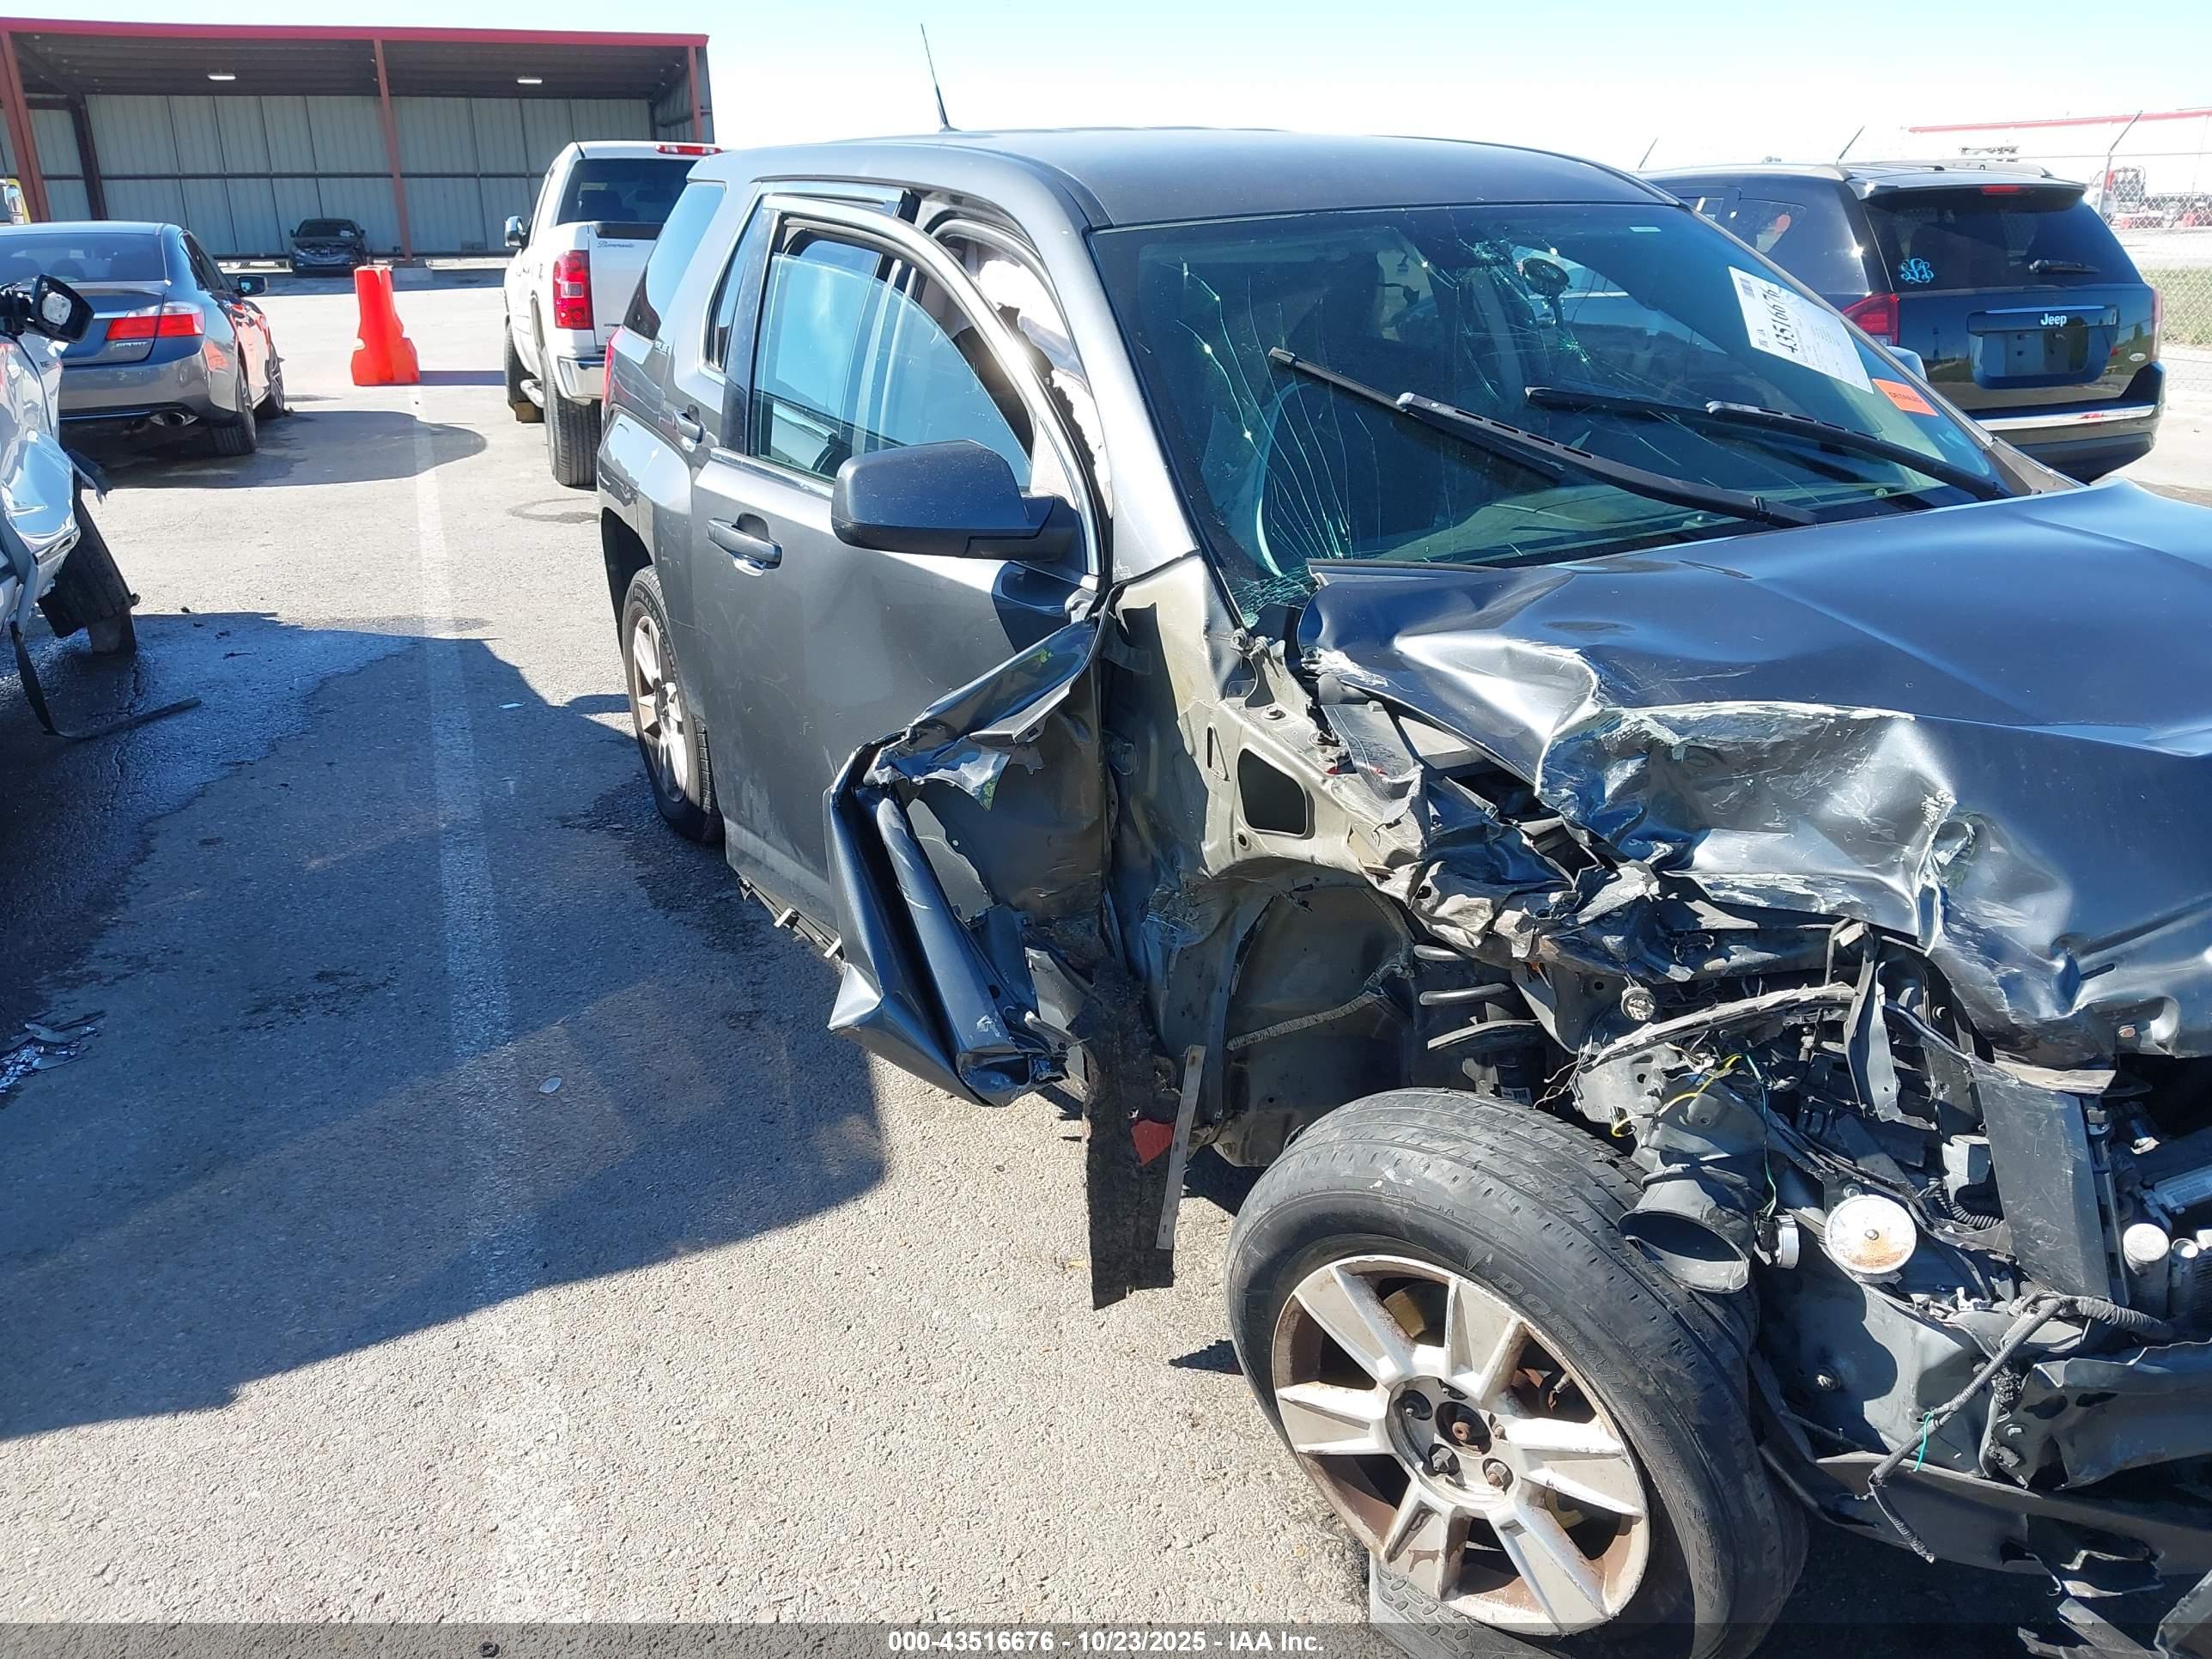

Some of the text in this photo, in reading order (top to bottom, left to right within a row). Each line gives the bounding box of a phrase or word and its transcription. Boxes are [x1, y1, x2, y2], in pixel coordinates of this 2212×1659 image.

[1761, 288, 1798, 354] 43516676
[2040, 313, 2068, 327] Jeep
[1492, 1273, 1629, 1395] DORAL
